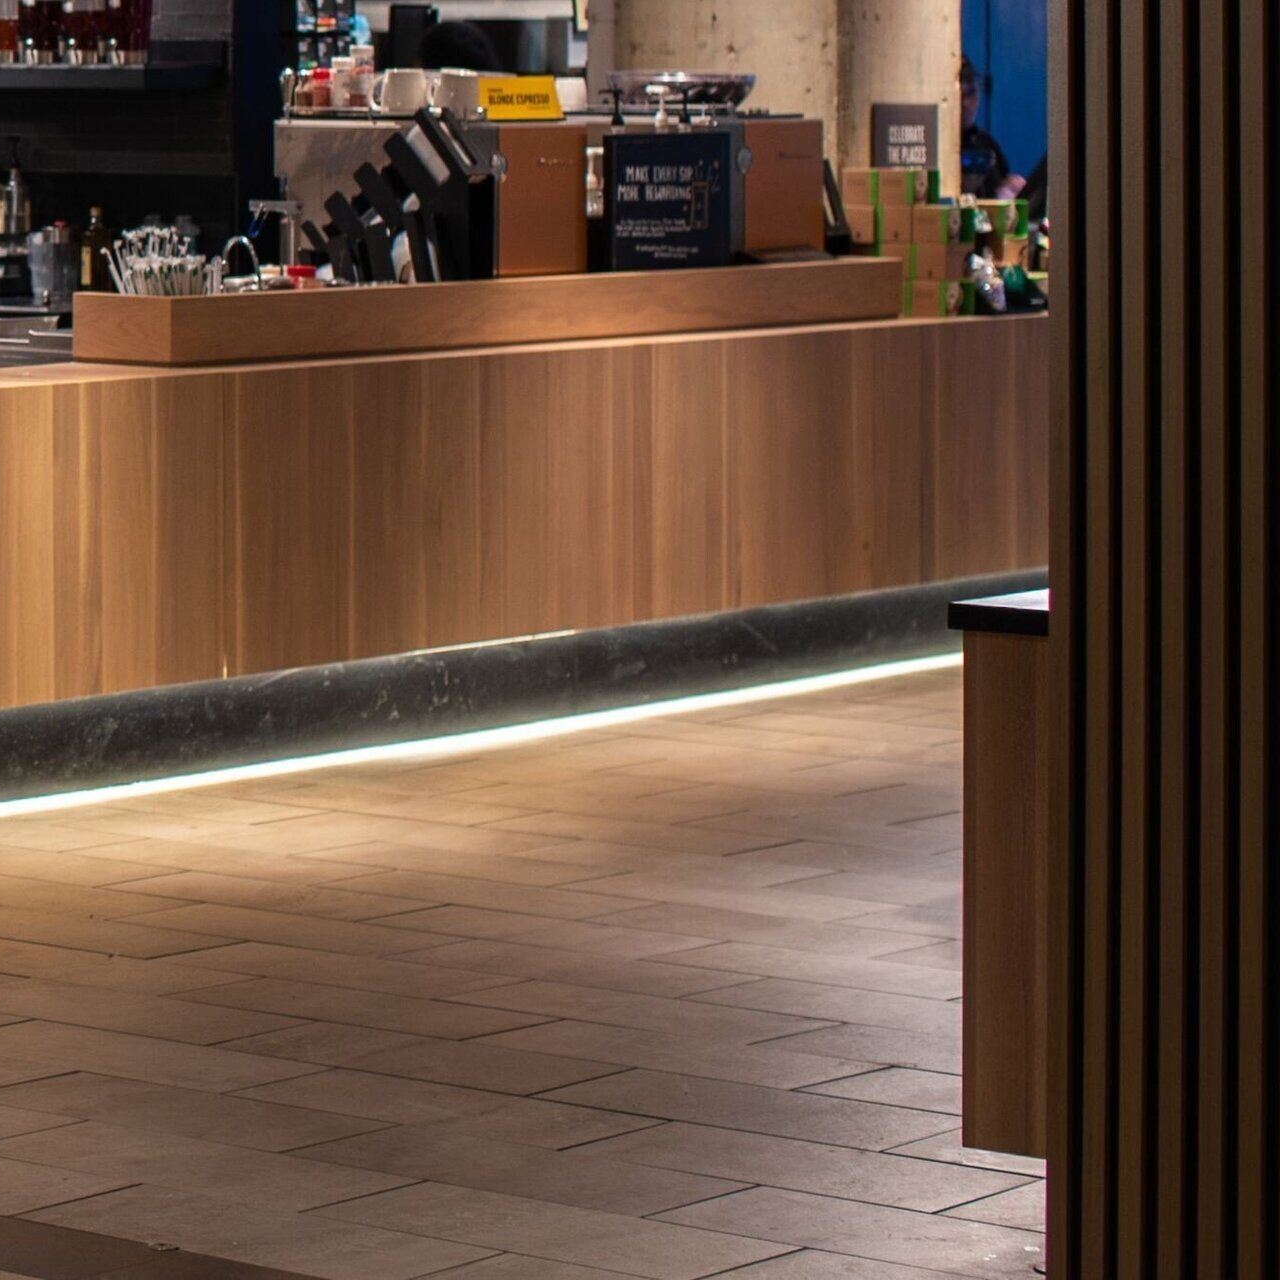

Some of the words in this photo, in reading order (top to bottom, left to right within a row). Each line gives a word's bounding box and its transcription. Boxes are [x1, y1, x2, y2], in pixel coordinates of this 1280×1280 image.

[516, 93, 550, 106] ESPRESSO
[889, 125, 925, 144] CELEBRATE
[888, 144, 900, 164] THE
